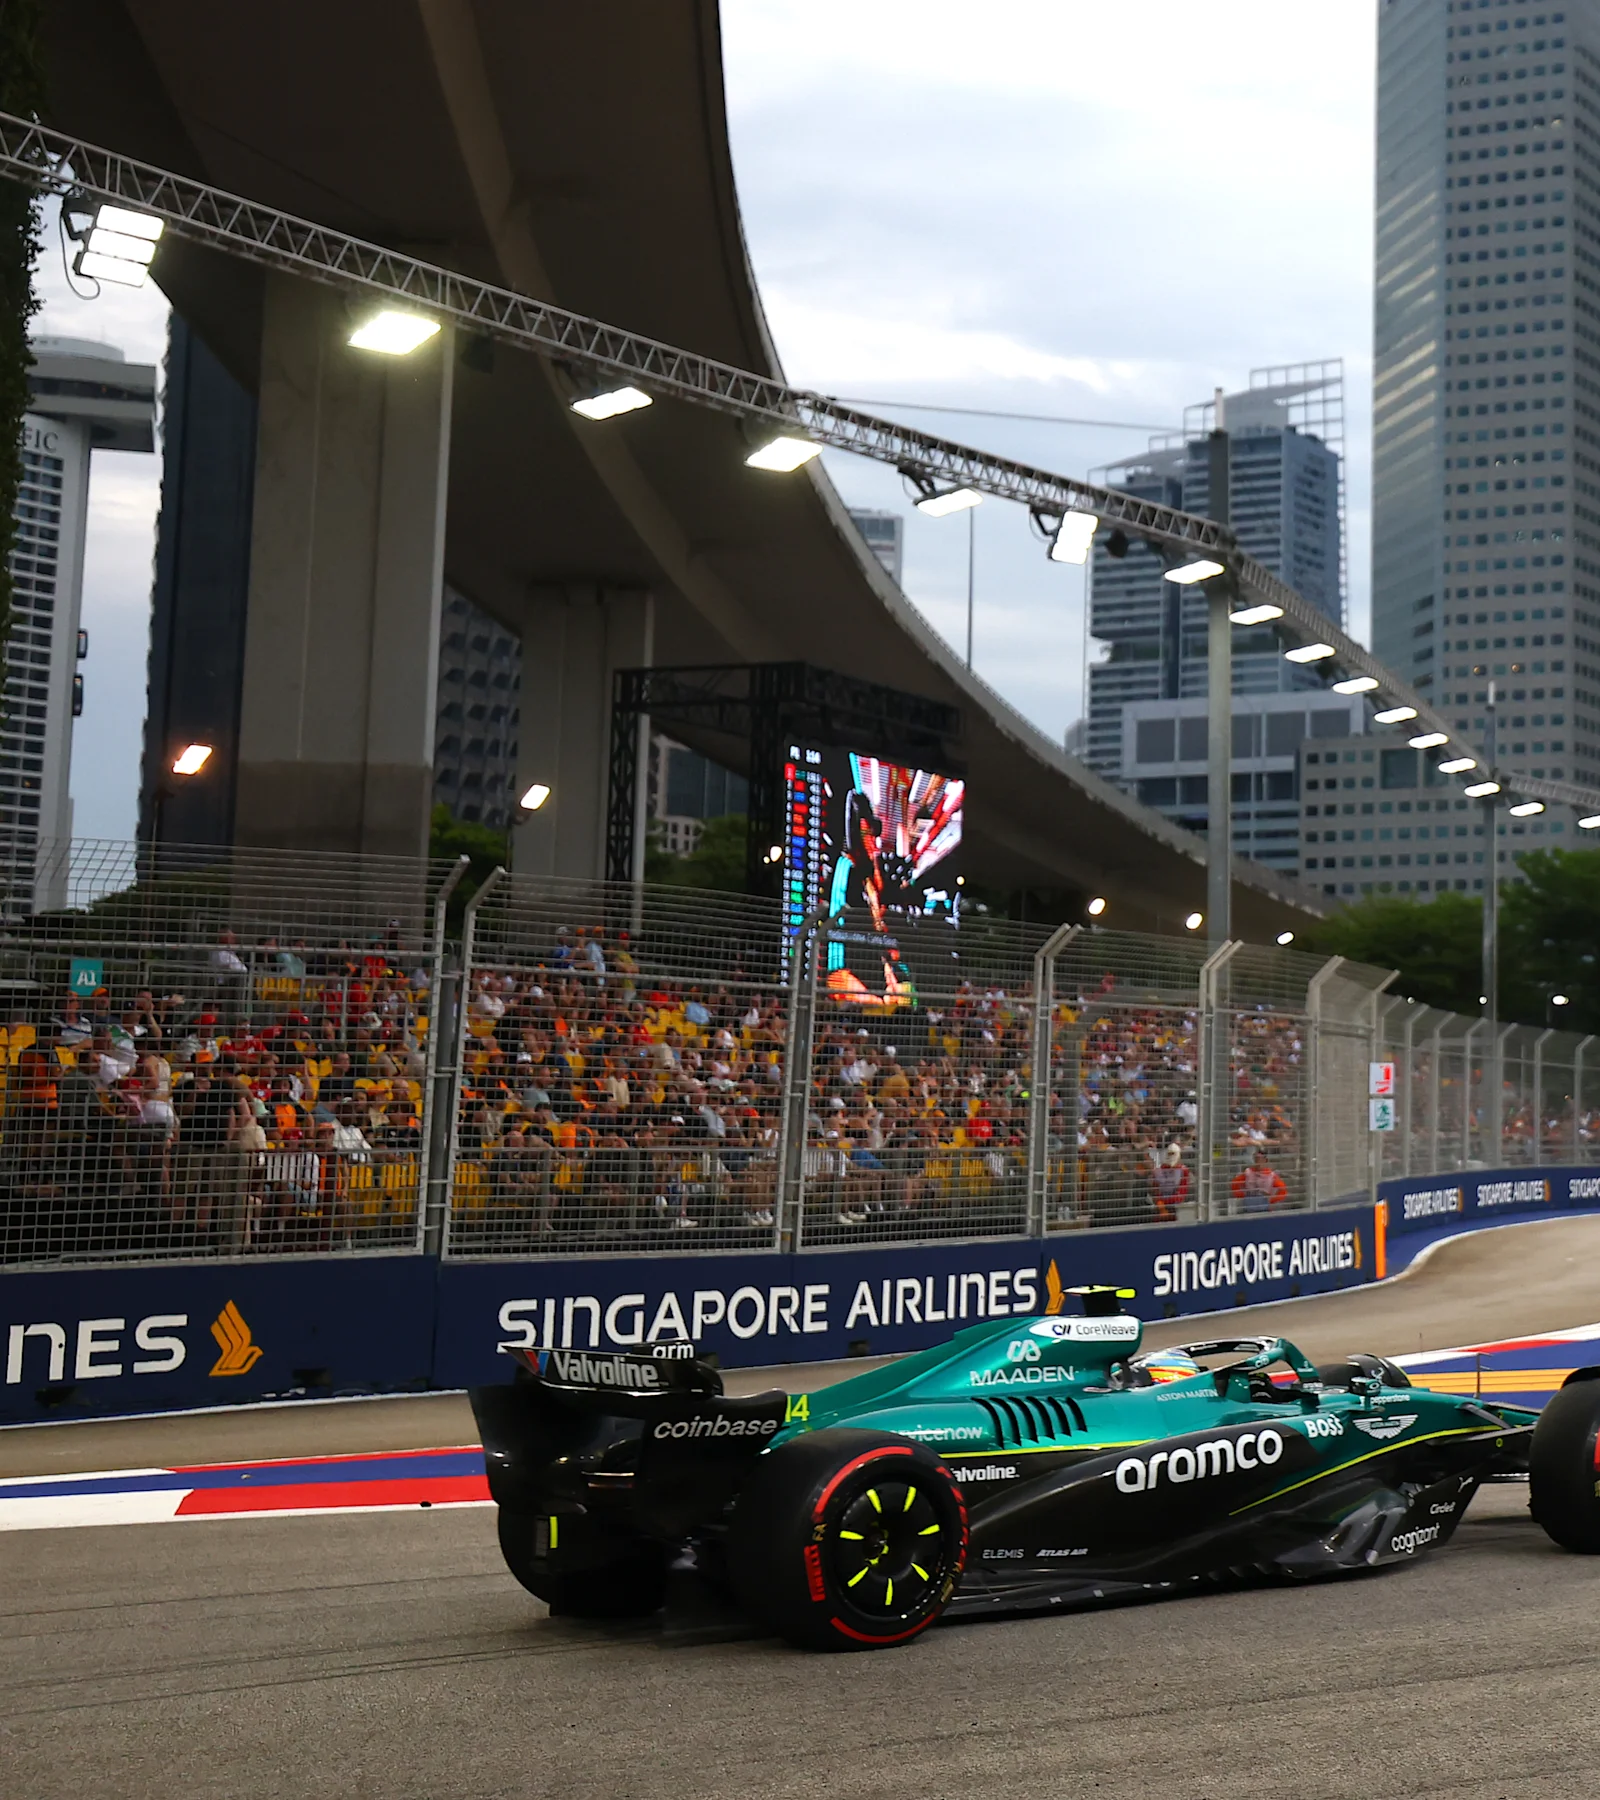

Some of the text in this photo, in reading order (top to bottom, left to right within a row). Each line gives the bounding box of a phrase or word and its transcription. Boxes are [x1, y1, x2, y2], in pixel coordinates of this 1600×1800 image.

[1477, 1179, 1544, 1207] SINGAPORE AIRLINES
[1153, 1231, 1354, 1296] SINGAPORE AIRLINES
[498, 1267, 1038, 1353] SINGAPORE AIRLINES
[1075, 1324, 1137, 1336] CoreWeave
[652, 1344, 695, 1360] arm
[552, 1351, 660, 1388] Valvoline
[969, 1365, 1076, 1387] MAADEN
[1156, 1388, 1219, 1402] ASTON MARTIN
[1370, 1394, 1410, 1405] pepperstone
[784, 1394, 810, 1422] 14
[653, 1415, 778, 1438] coinbase
[1303, 1413, 1344, 1438] BOSS
[1115, 1429, 1284, 1493] aramco
[950, 1465, 1016, 1482] alvoline
[1391, 1522, 1440, 1554] cognizant
[982, 1549, 1024, 1559] ELEMIS
[1036, 1548, 1089, 1557] ATLAS AIR
